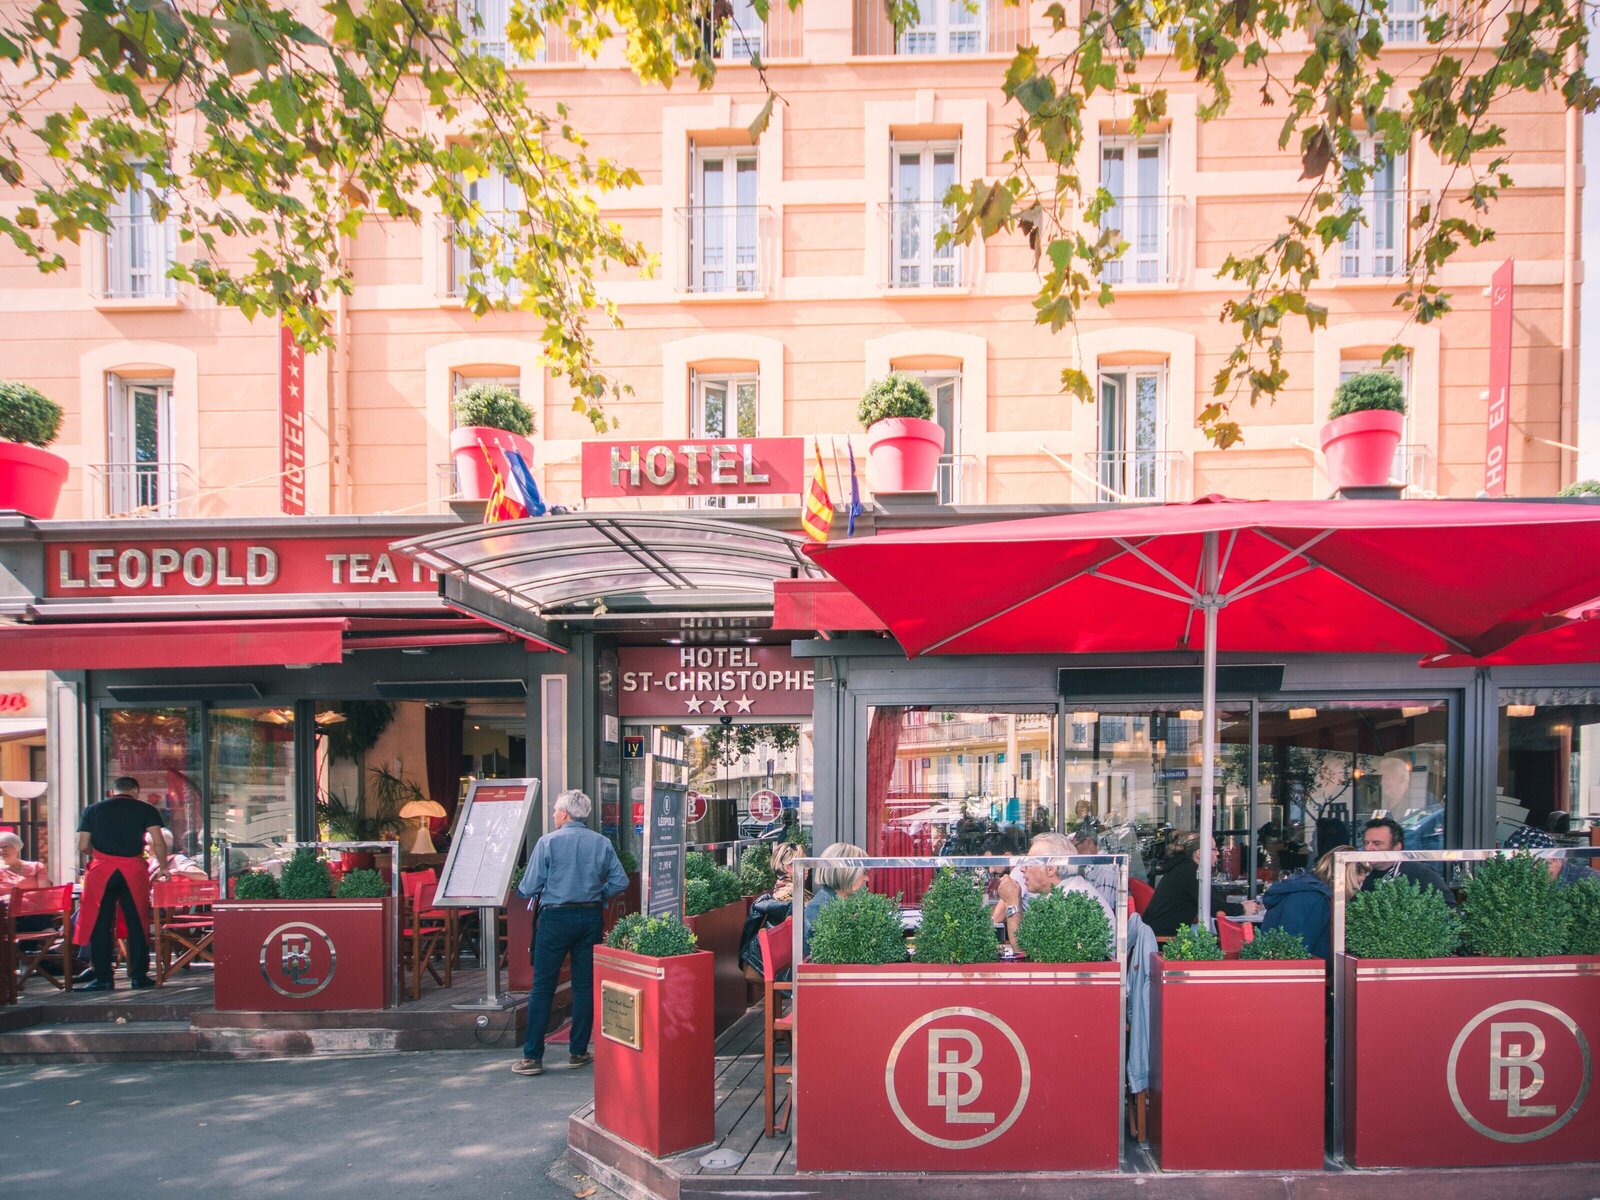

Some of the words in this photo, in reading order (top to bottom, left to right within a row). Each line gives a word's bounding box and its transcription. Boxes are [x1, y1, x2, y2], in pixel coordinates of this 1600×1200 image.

[284, 411, 304, 507] HOTEL
[610, 443, 770, 486] HOTEL
[59, 546, 279, 589] LEOPOLD
[325, 553, 399, 584] TEA
[680, 647, 759, 668] HOTEL
[622, 670, 815, 692] ST-CHRISTOPHE
